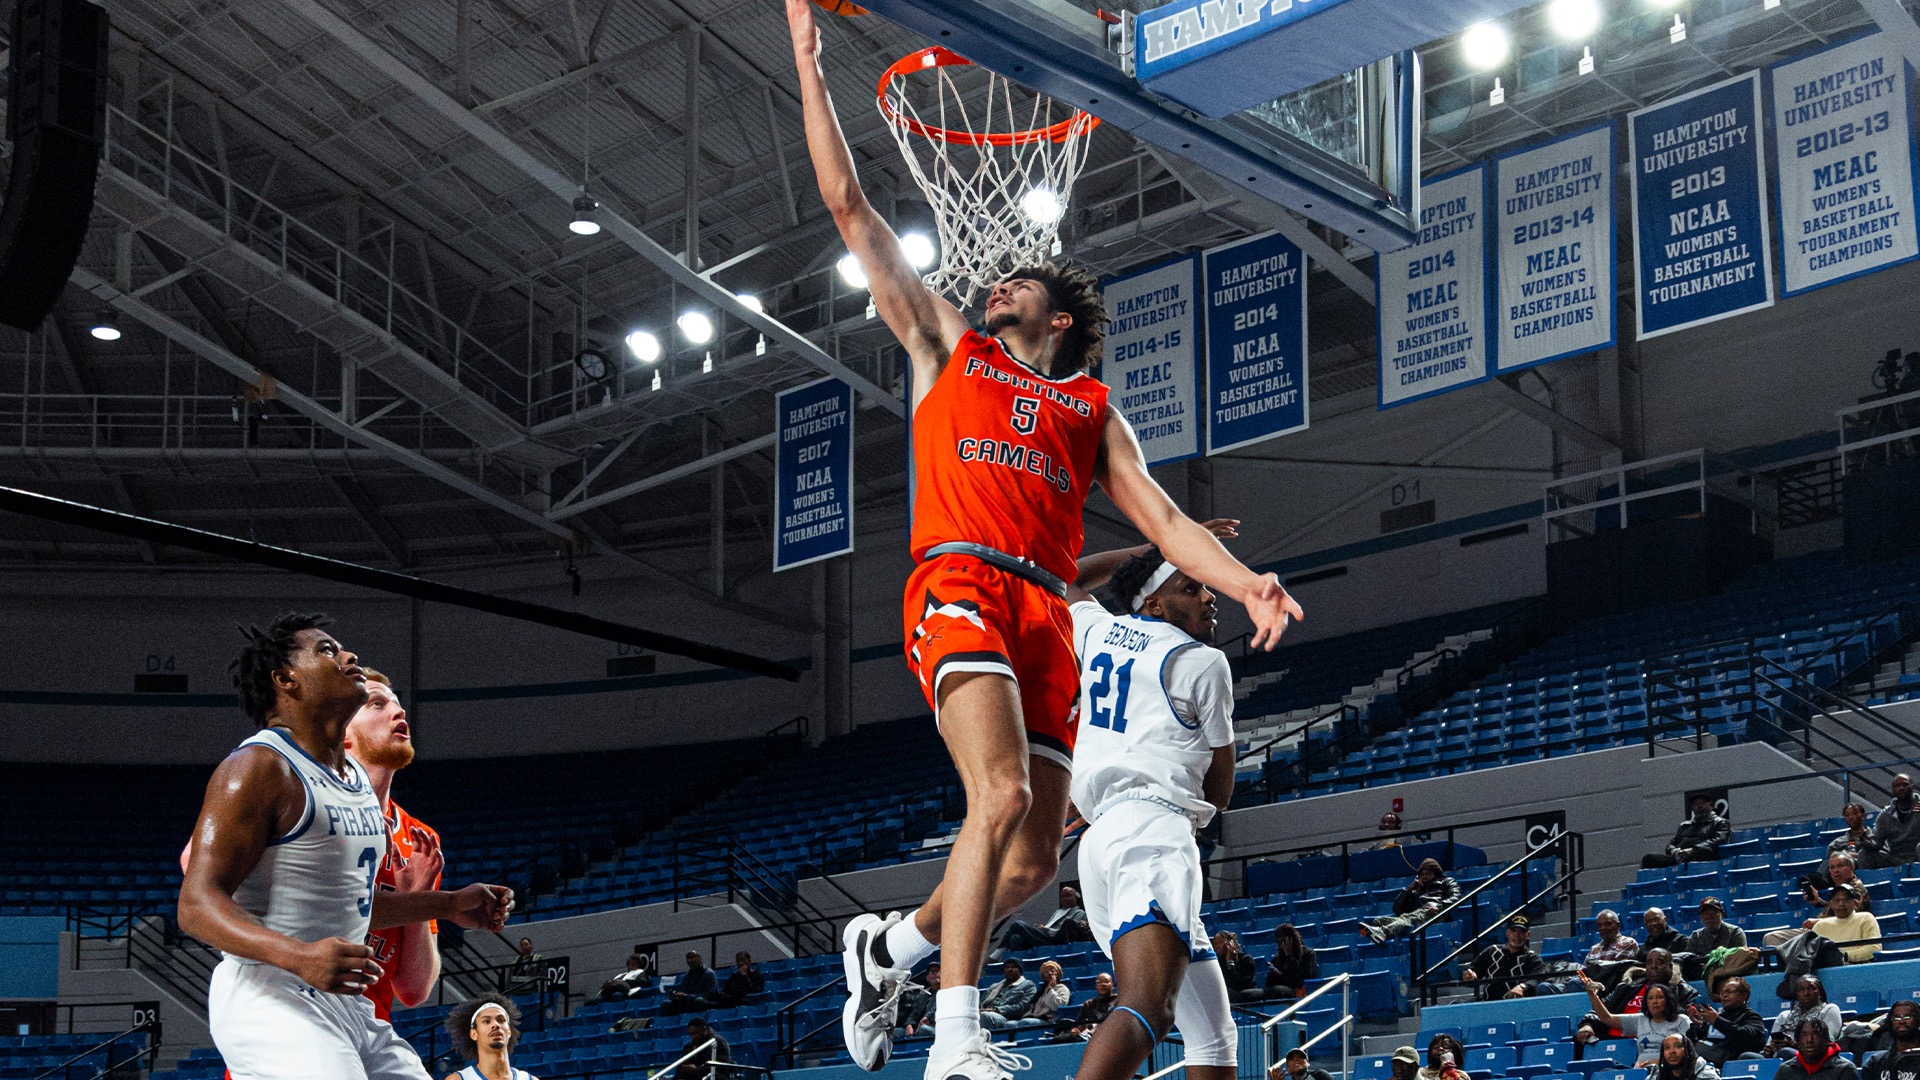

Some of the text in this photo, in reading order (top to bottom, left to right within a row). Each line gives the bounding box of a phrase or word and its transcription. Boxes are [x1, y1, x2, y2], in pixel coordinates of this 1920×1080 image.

[1794, 57, 1884, 104] HAMPTON
[1784, 74, 1896, 127] UNIVERSITY
[1654, 108, 1737, 150] HAMPTON
[1797, 111, 1890, 158] 2012-13
[1643, 125, 1749, 173] UNIVERSITY
[1515, 156, 1593, 193] HAMPTON
[1671, 166, 1726, 199] 2013
[1813, 151, 1878, 191] MEAC
[1420, 196, 1466, 225] MPTON
[1506, 173, 1602, 215] UNIVERSITY
[1813, 179, 1881, 212] WOMEN'S
[1411, 212, 1476, 246] VERSITY
[1513, 206, 1594, 245] 2013-14
[1670, 199, 1731, 236] NCAA
[1803, 196, 1894, 234] BASKETBALL
[1665, 225, 1737, 259] WOMEN'S
[1799, 212, 1900, 254] TOURNAMENT
[1222, 252, 1288, 286] HAMPTON
[1408, 250, 1455, 279] 2014
[1526, 242, 1581, 276] MEAC
[1655, 244, 1749, 283] BASKETBALL
[1809, 234, 1893, 271] CHAMPIONS
[1214, 268, 1297, 306] UNIVERSITY
[1407, 280, 1458, 314] MEAC
[1521, 268, 1586, 297] WOMEN'S
[1649, 262, 1756, 305] TOURNAMENT
[1117, 284, 1180, 316] HAMPTON
[1510, 286, 1597, 320] BASKETBALL
[1109, 300, 1187, 336] UNIVERSITY
[1234, 303, 1278, 331] 2014
[1406, 307, 1459, 332] WOMEN'S
[1514, 306, 1593, 340] CHAMPIONS
[1115, 330, 1181, 362] 2014-15
[1233, 333, 1279, 364] NCAA
[1393, 337, 1472, 370] TOURNAMENT
[1397, 322, 1469, 352] BASKETBALL
[965, 357, 1091, 417] FIGHTING
[1126, 362, 1172, 390] MEAC
[1229, 357, 1284, 384] WOMEN'S
[1401, 356, 1466, 386] CHAMPIONS
[1121, 386, 1176, 410] WOMEN'S
[1220, 373, 1292, 405] BASKETBALL
[789, 396, 839, 424] HAMPTON
[1010, 395, 1041, 435] 5
[1124, 402, 1184, 426] SKETBALL
[1216, 390, 1297, 424] TOURNAMENT
[784, 411, 846, 442] UNIVERSITY
[799, 440, 831, 464] 2017
[958, 437, 1071, 492] CAMELS
[796, 466, 832, 492] NCAA
[1392, 479, 1421, 506] D1
[793, 488, 835, 510] WOMEN'S
[783, 518, 844, 545] TOURNAMENT
[786, 503, 842, 529] BASKETBALL
[1104, 622, 1154, 653] BENSON
[1089, 652, 1136, 734] 21
[1526, 822, 1560, 850] C1
[357, 847, 377, 918] 3
[547, 965, 566, 986] D2
[133, 1009, 156, 1027] D3
